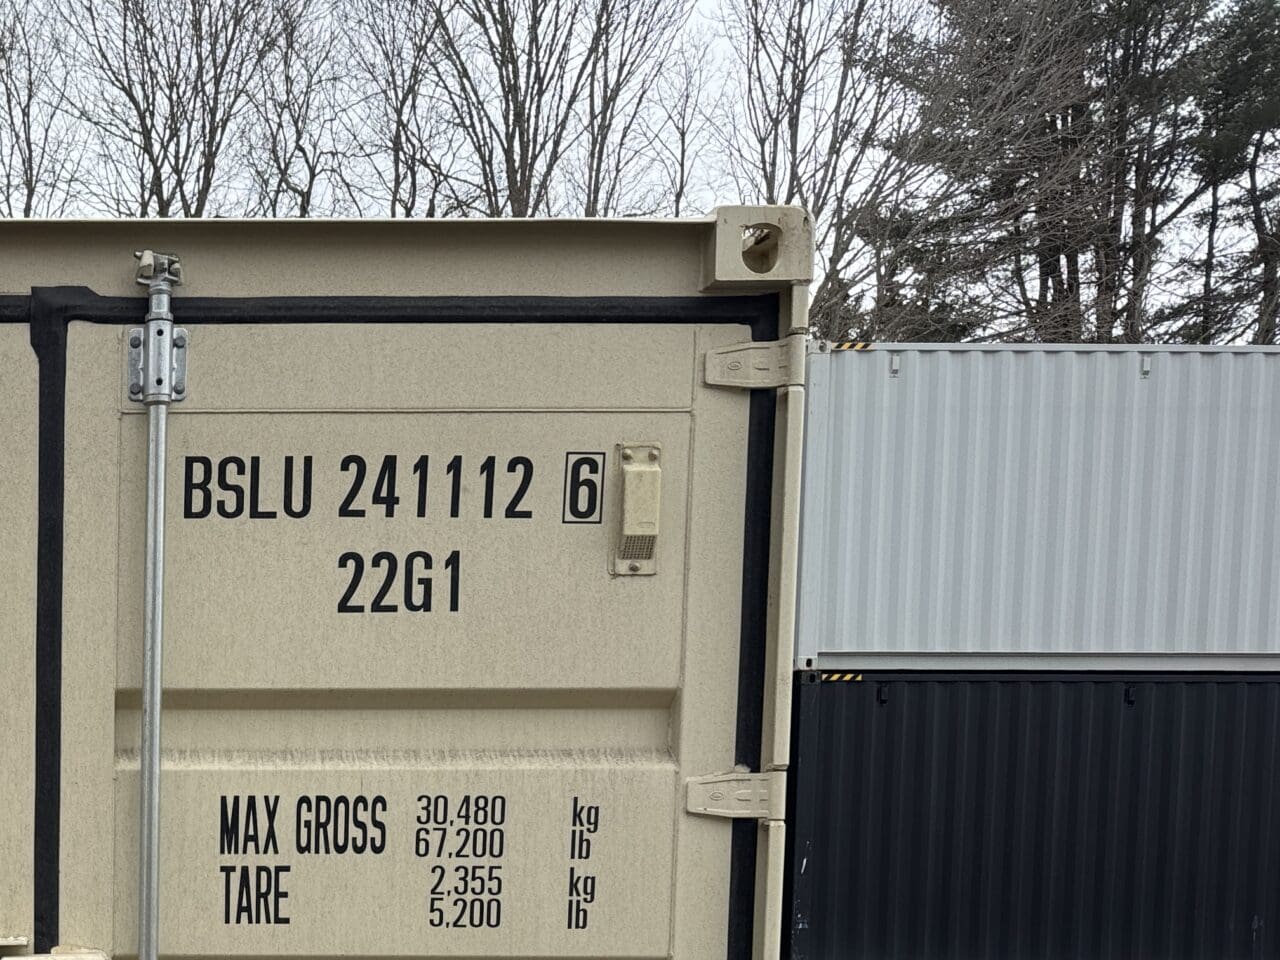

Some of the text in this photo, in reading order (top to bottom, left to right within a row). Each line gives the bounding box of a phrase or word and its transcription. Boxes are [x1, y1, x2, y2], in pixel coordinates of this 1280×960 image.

[183, 454, 599, 520] BSLU 241112 6
[337, 550, 461, 614] 22G1
[220, 795, 600, 856] MAX GROSS 30,480 kg
[414, 828, 591, 860] 67,200 lb
[220, 865, 596, 925] TARE 2,355 kg
[428, 898, 588, 930] 5,200 lb
